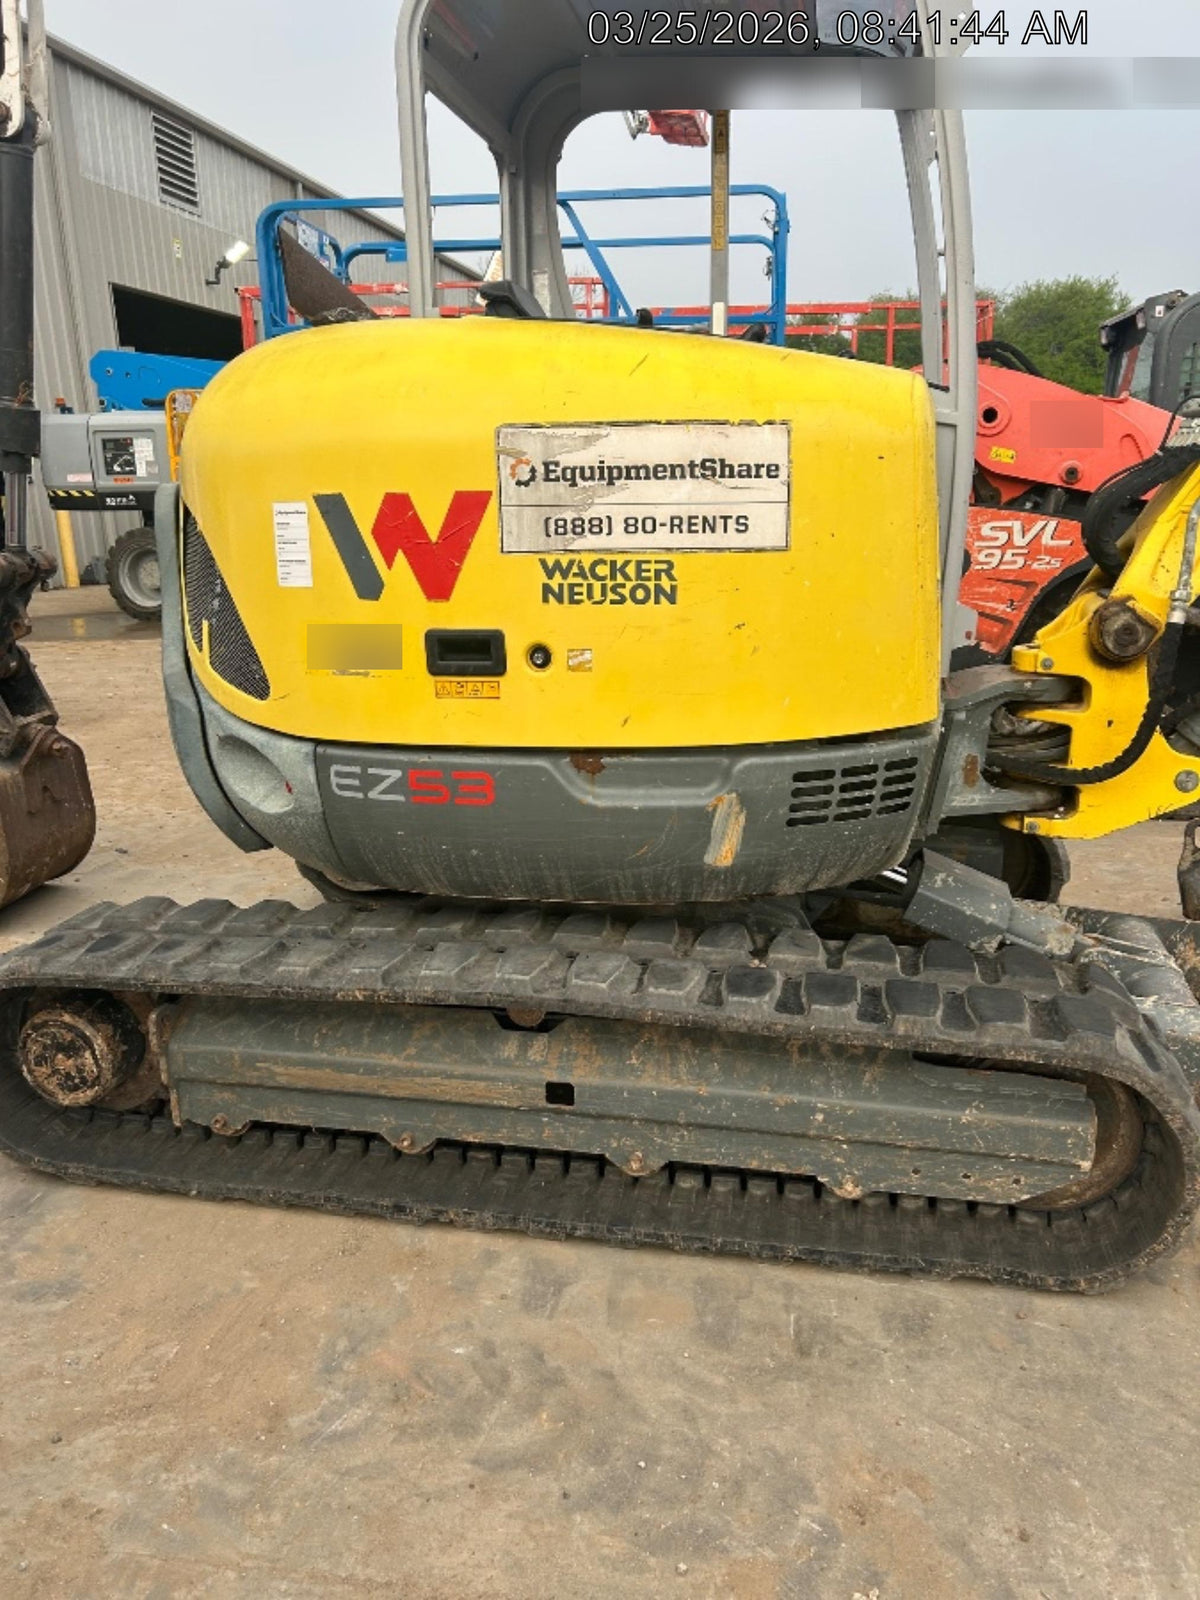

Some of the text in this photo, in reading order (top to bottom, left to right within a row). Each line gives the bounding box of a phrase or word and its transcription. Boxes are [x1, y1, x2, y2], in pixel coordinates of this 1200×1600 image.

[542, 458, 780, 488] EquipmentShare
[544, 515, 750, 537] (888) 80-RENTS
[974, 520, 1073, 547] SVL
[538, 558, 678, 582] WACKER
[541, 583, 678, 606] NEUSON
[329, 764, 496, 806] EZ53
